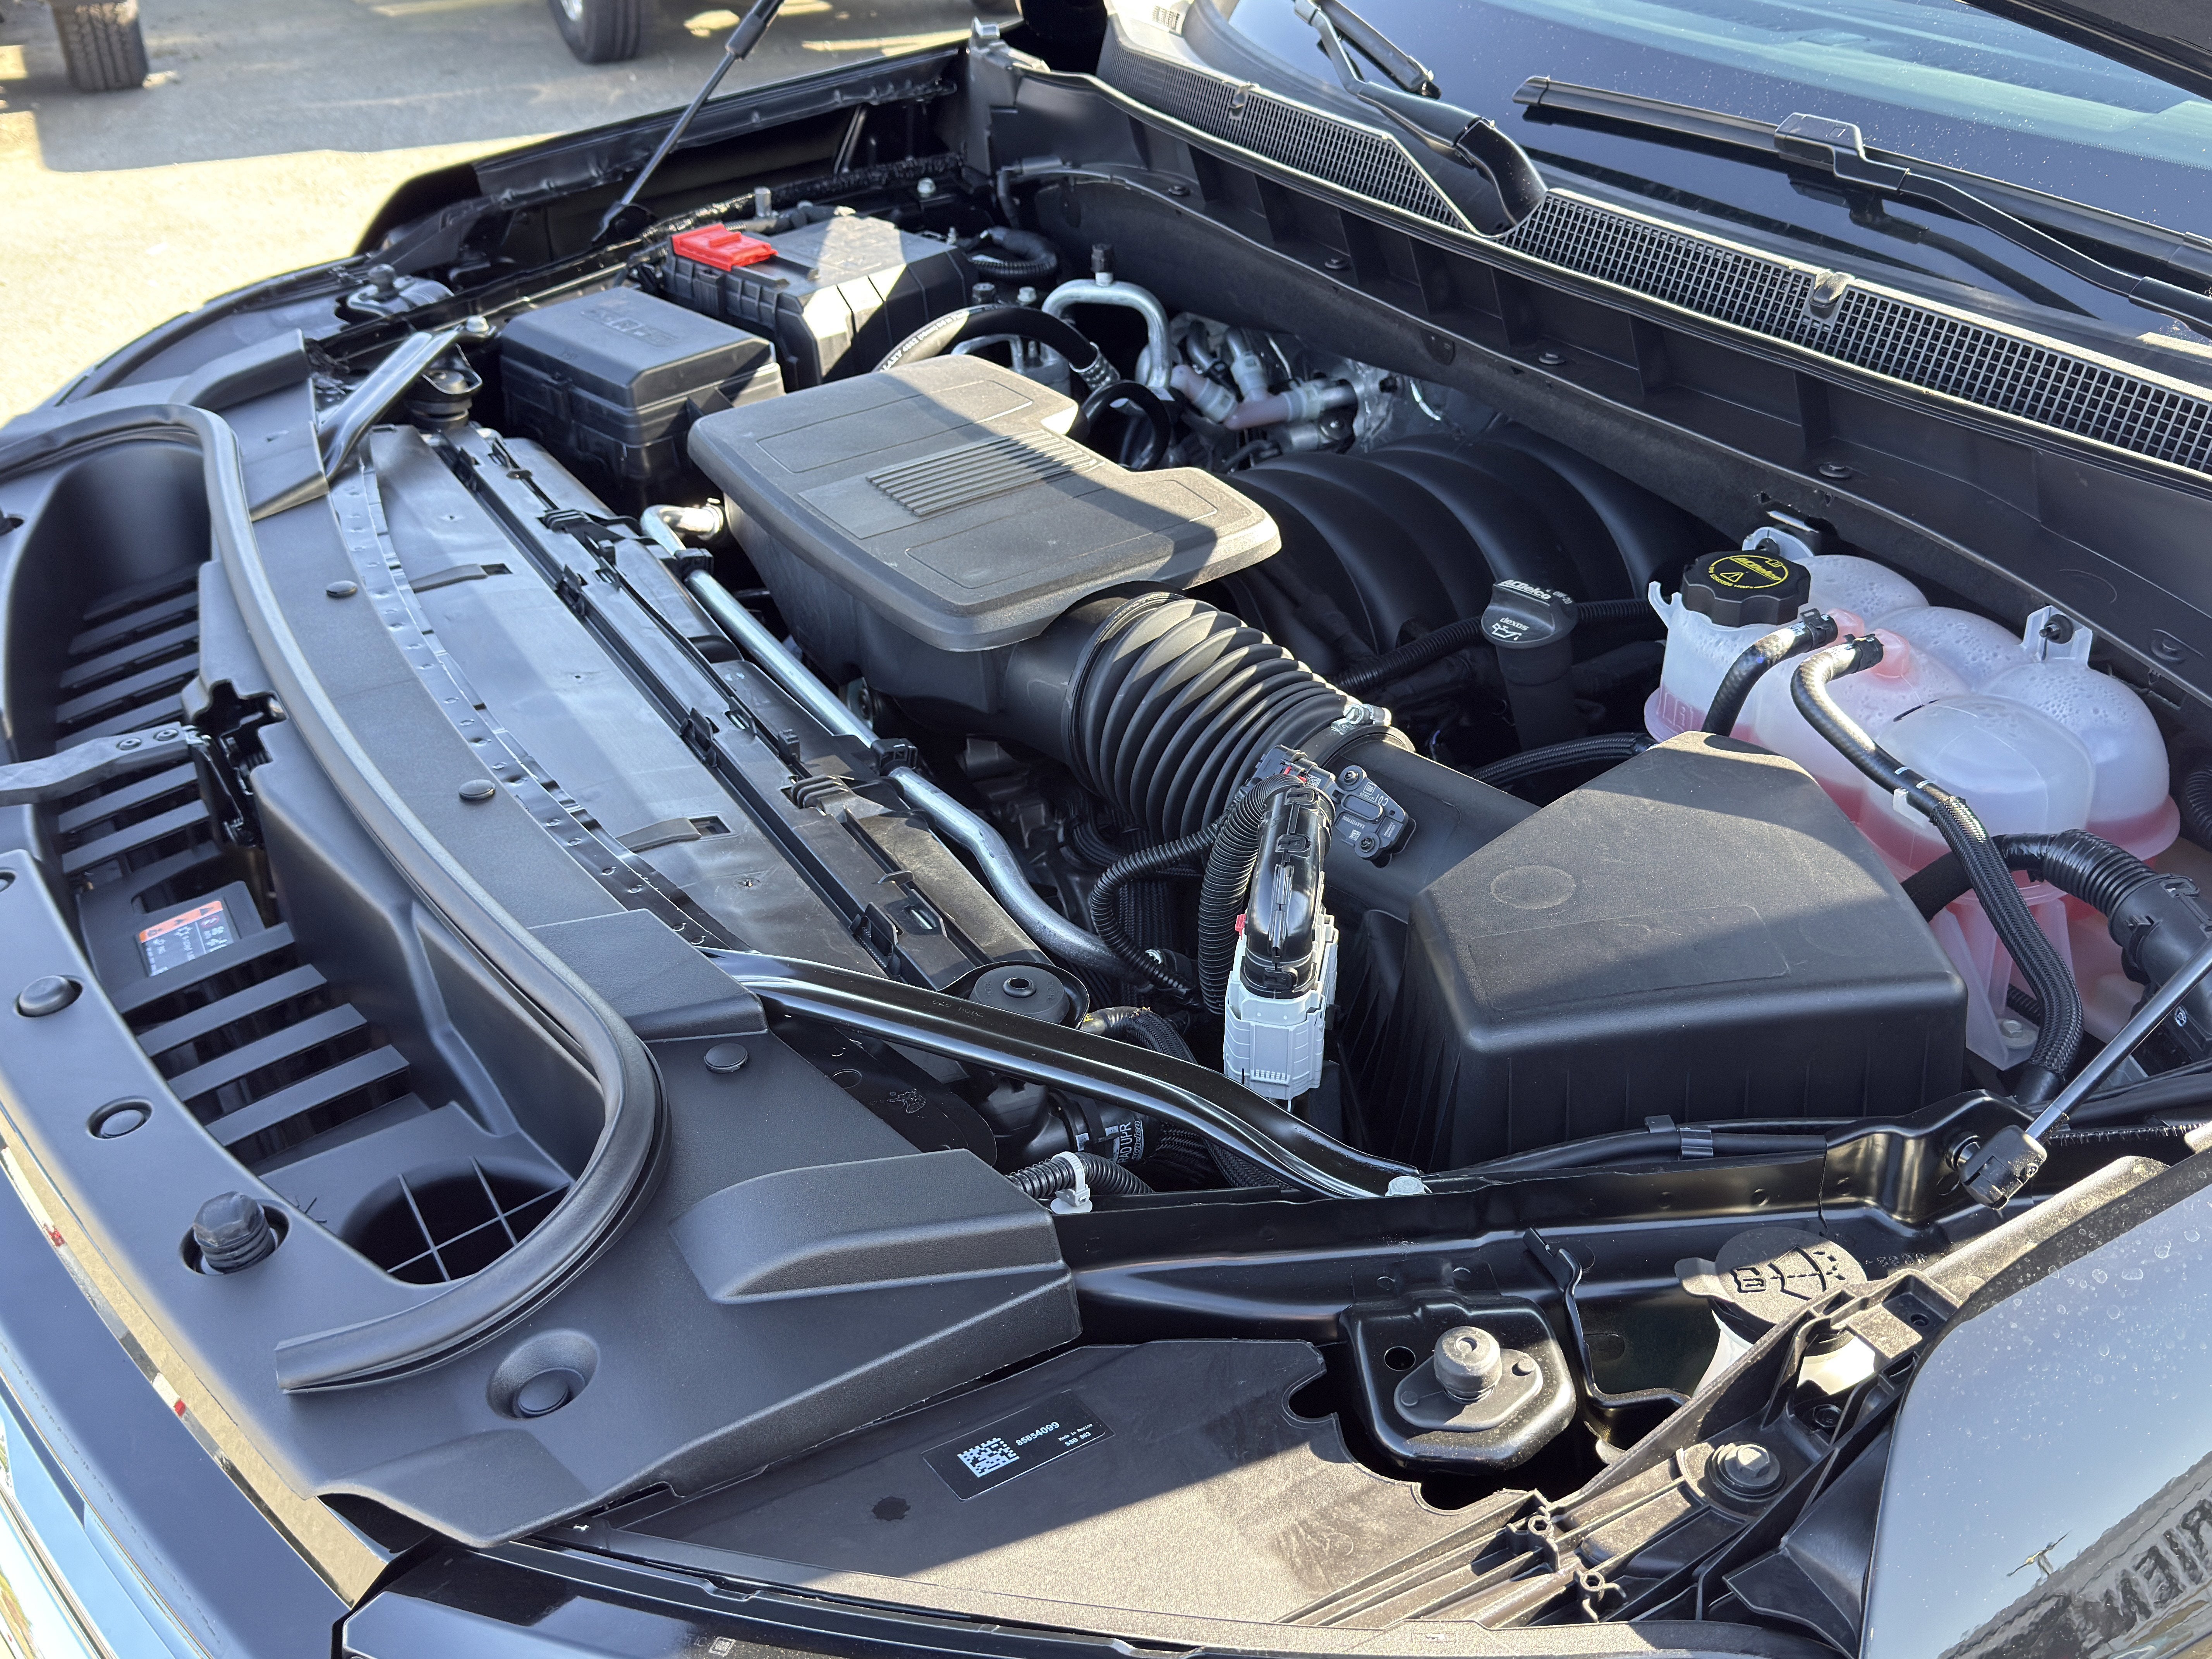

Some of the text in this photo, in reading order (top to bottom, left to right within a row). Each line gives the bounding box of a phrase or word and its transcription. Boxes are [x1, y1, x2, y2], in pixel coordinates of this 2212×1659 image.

[1499, 579, 1551, 600] ACDelco
[1500, 617, 1530, 631] dexos
[1116, 1121, 1132, 1163] RAD UPR
[1015, 1422, 1060, 1446] 85854099
